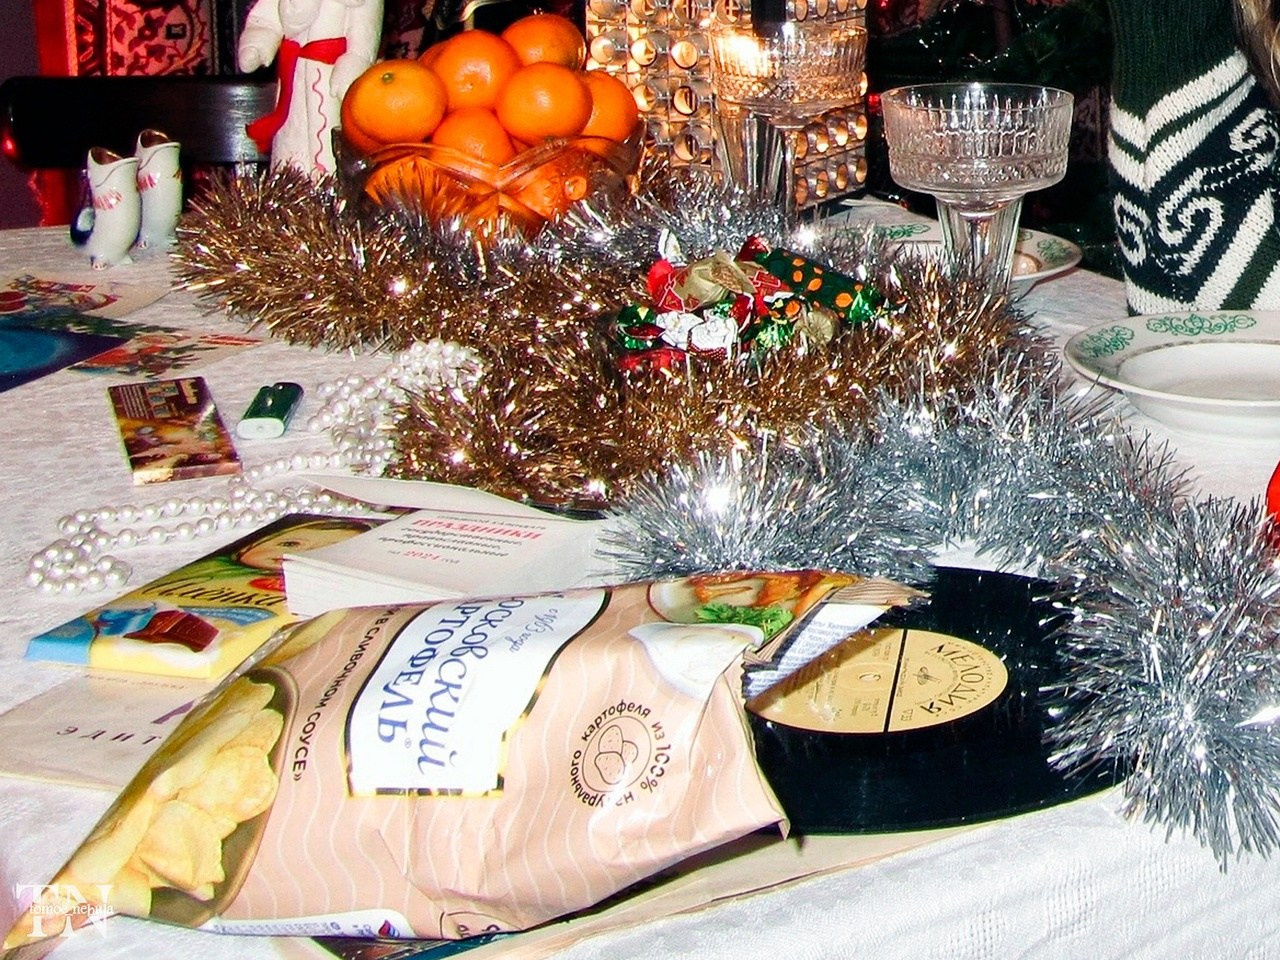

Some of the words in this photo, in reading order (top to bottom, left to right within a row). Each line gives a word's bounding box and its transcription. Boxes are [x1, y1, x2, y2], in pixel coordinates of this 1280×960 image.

[411, 518, 543, 540] ПРАЗДНИКИ
[313, 626, 381, 709] СЛИВОЧНОМ
[377, 602, 485, 744] РТОФЕЛЬ
[416, 596, 525, 775] осковский
[581, 698, 652, 742] картофеля
